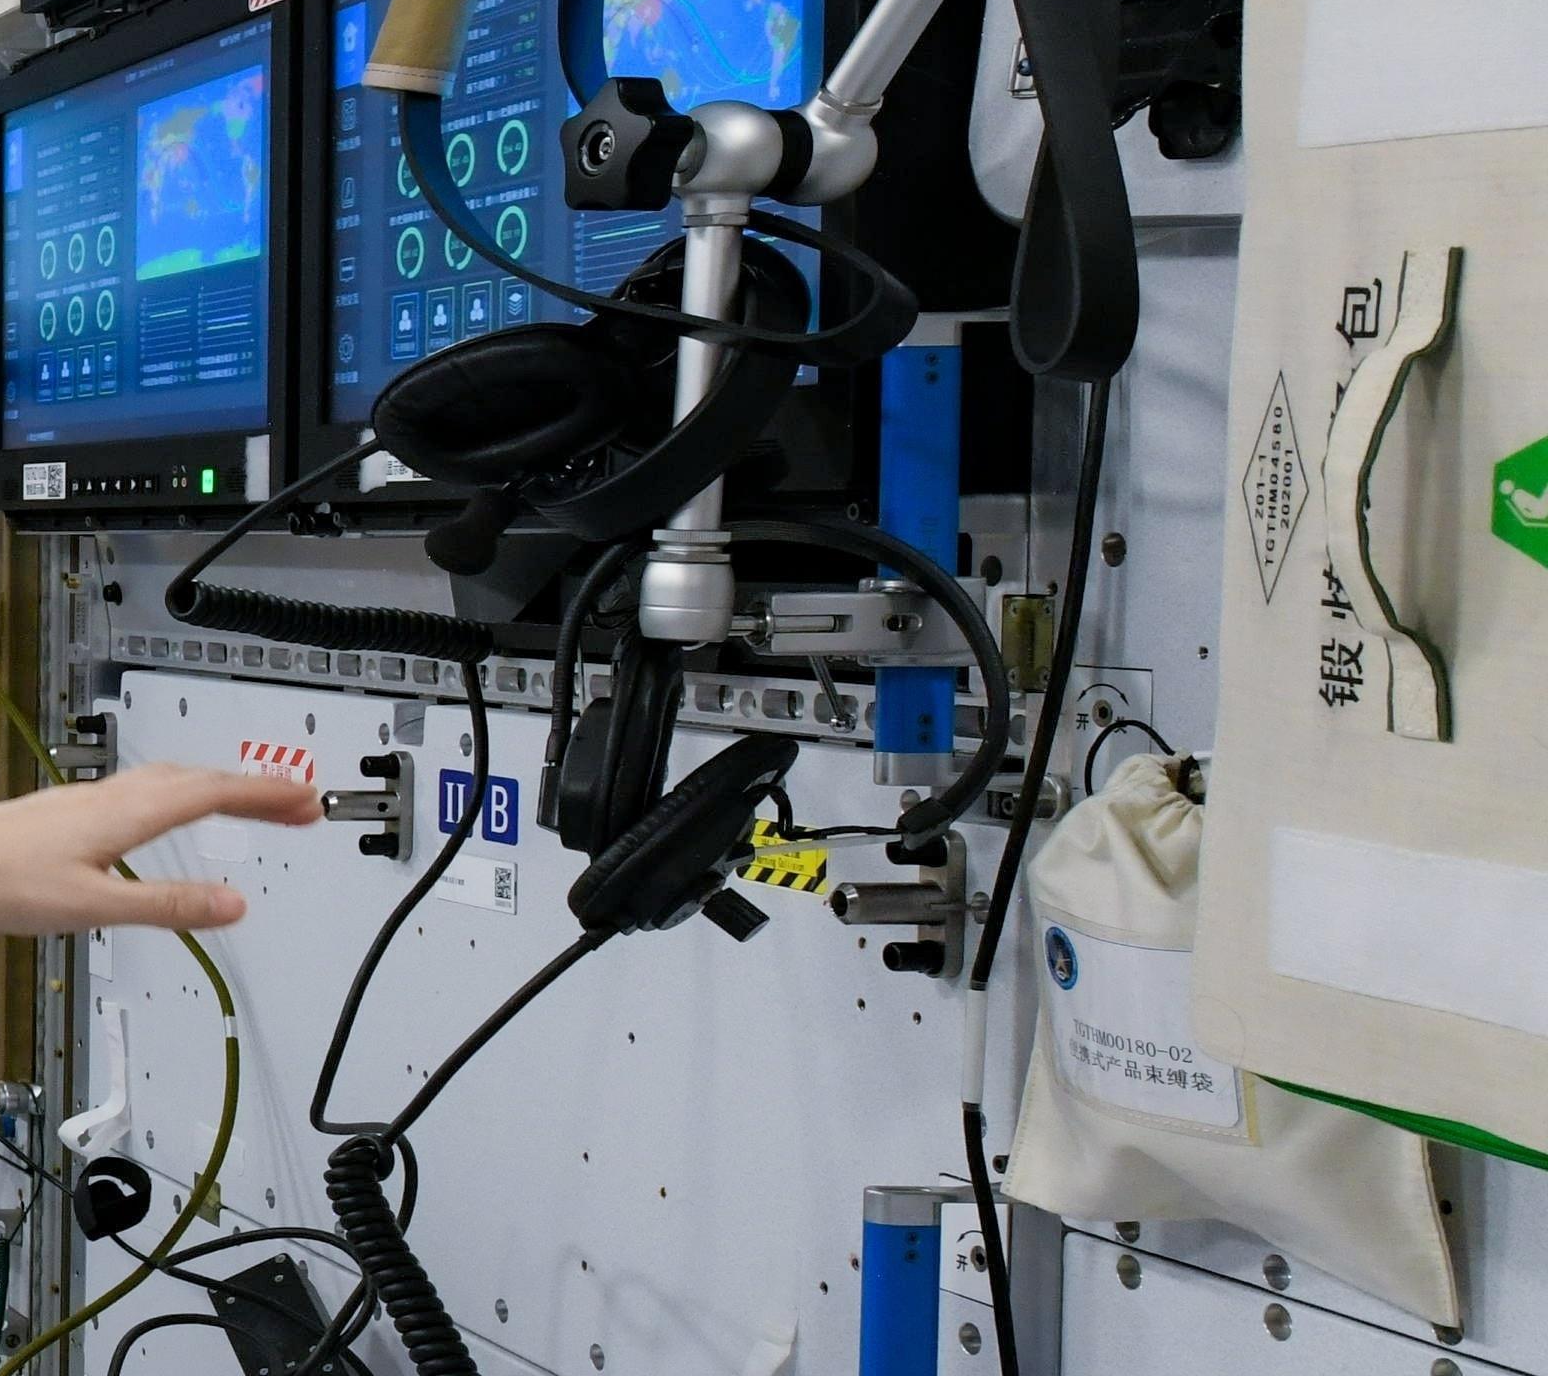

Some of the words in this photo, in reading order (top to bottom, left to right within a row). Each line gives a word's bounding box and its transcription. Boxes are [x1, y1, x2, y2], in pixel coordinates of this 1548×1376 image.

[1076, 712, 1090, 731] 开
[490, 784, 508, 833] B
[1073, 1018, 1193, 1065] TGTHM00180-02
[1069, 1039, 1215, 1095] 便携式产品束缚袋
[955, 1254, 969, 1273] 开
